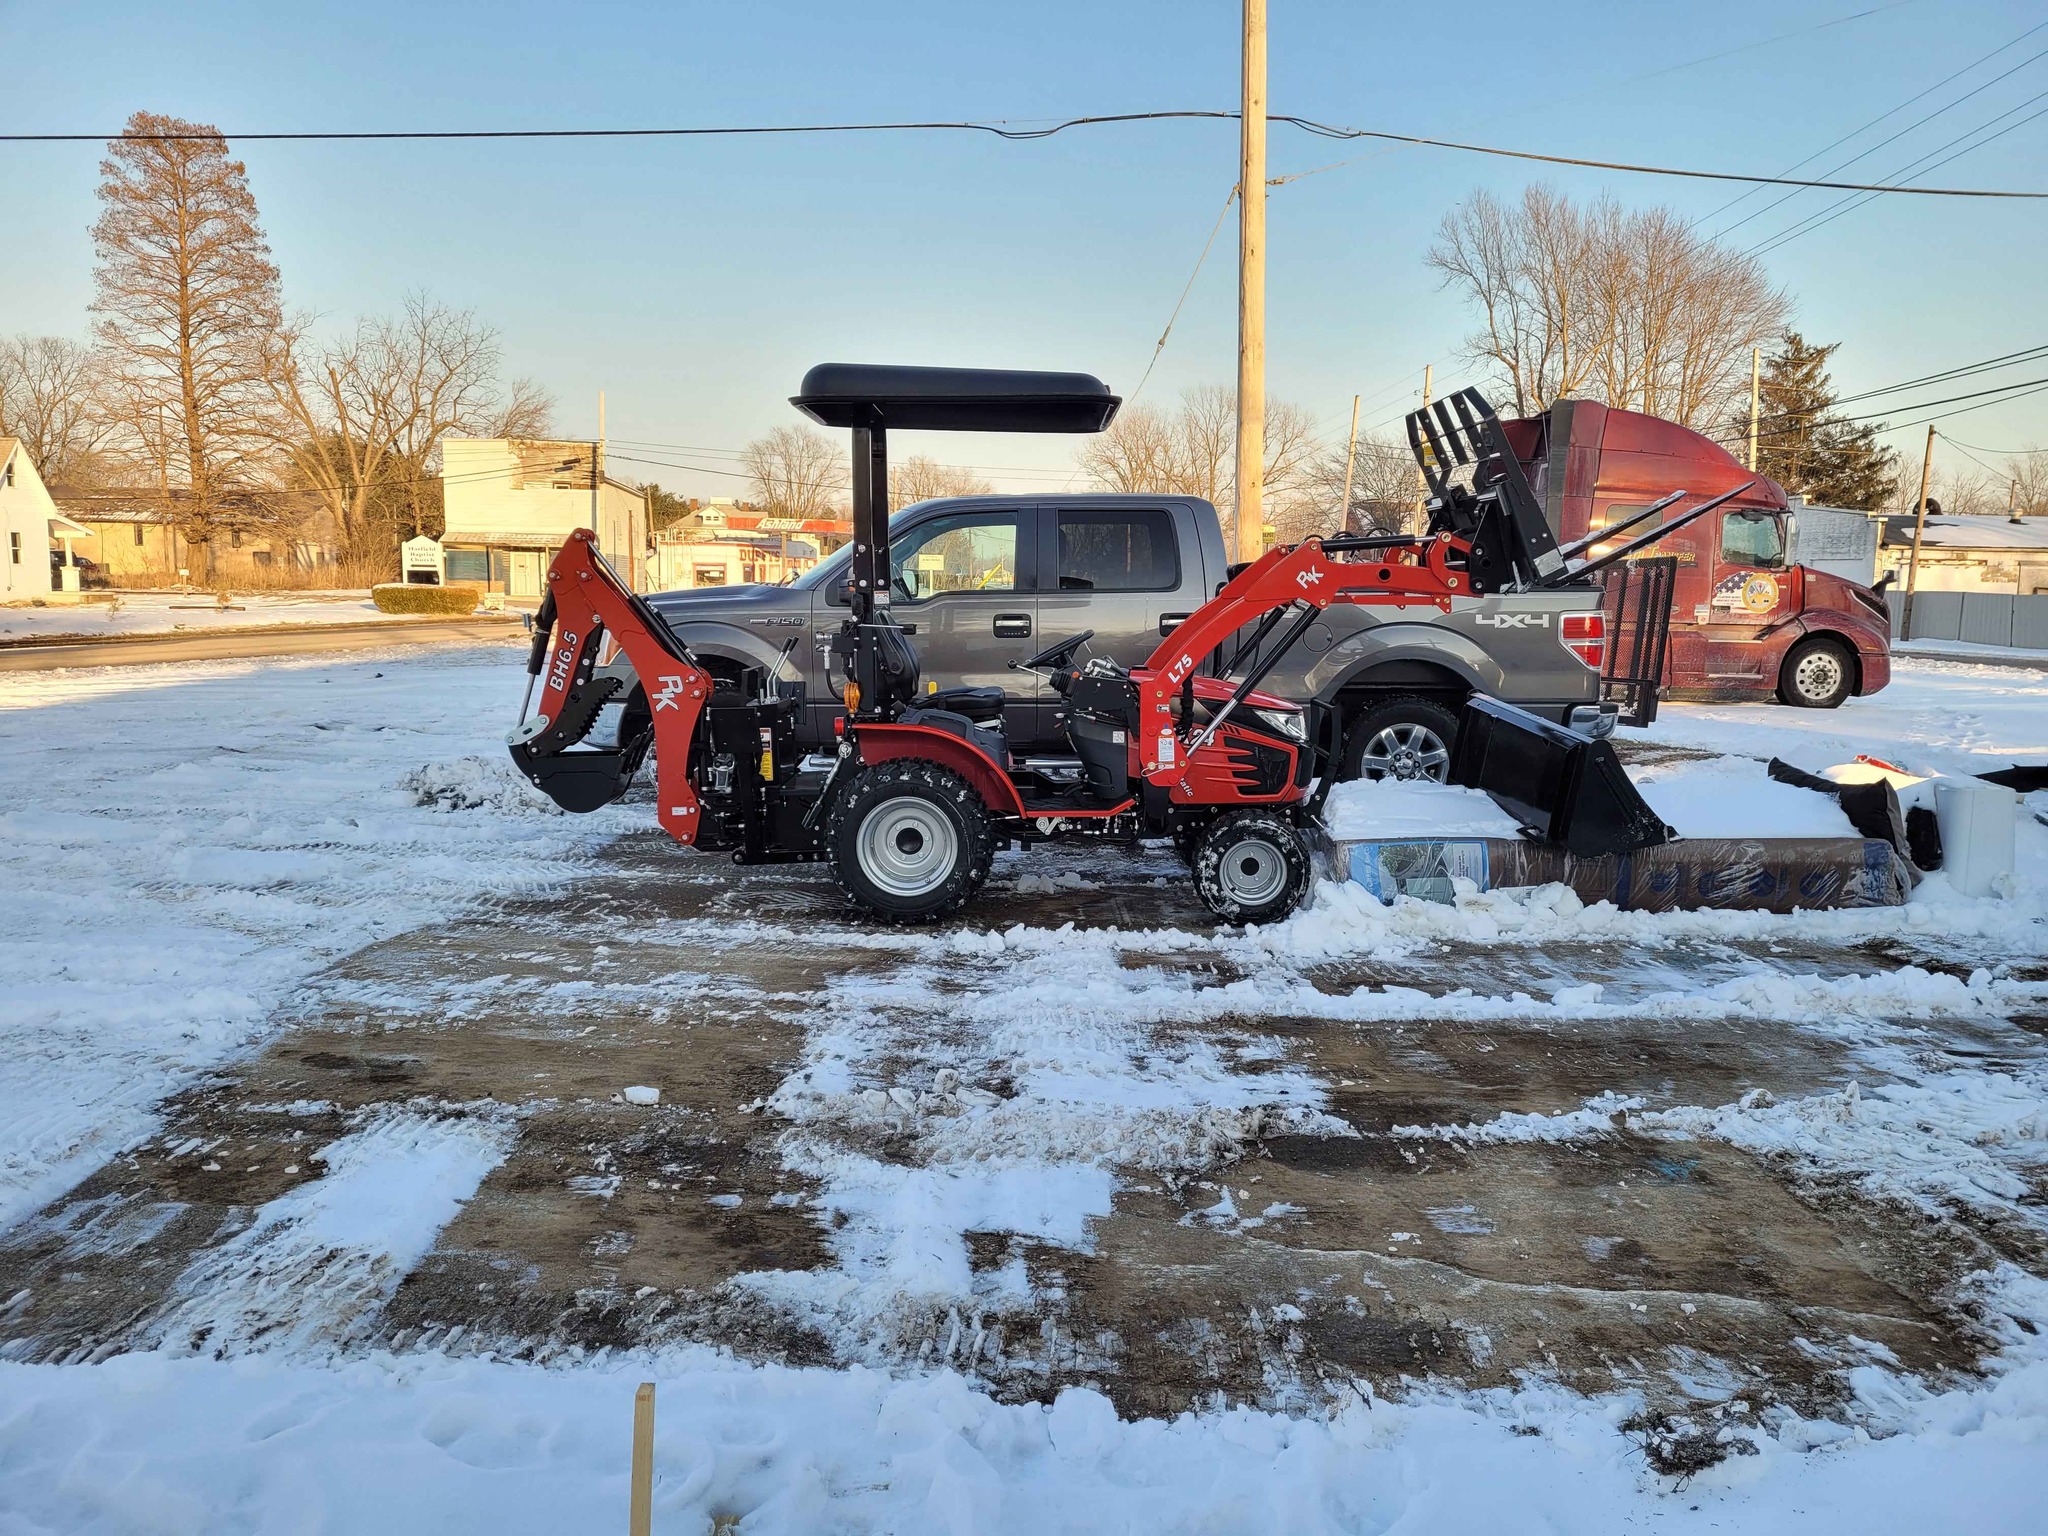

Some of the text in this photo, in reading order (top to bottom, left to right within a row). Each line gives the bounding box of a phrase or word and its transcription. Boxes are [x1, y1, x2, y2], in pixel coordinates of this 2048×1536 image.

[756, 518, 805, 530] Ashland
[1296, 564, 1325, 589] RK
[549, 630, 578, 692] BH6.5
[1167, 653, 1193, 684] L75
[651, 675, 684, 713] RK
